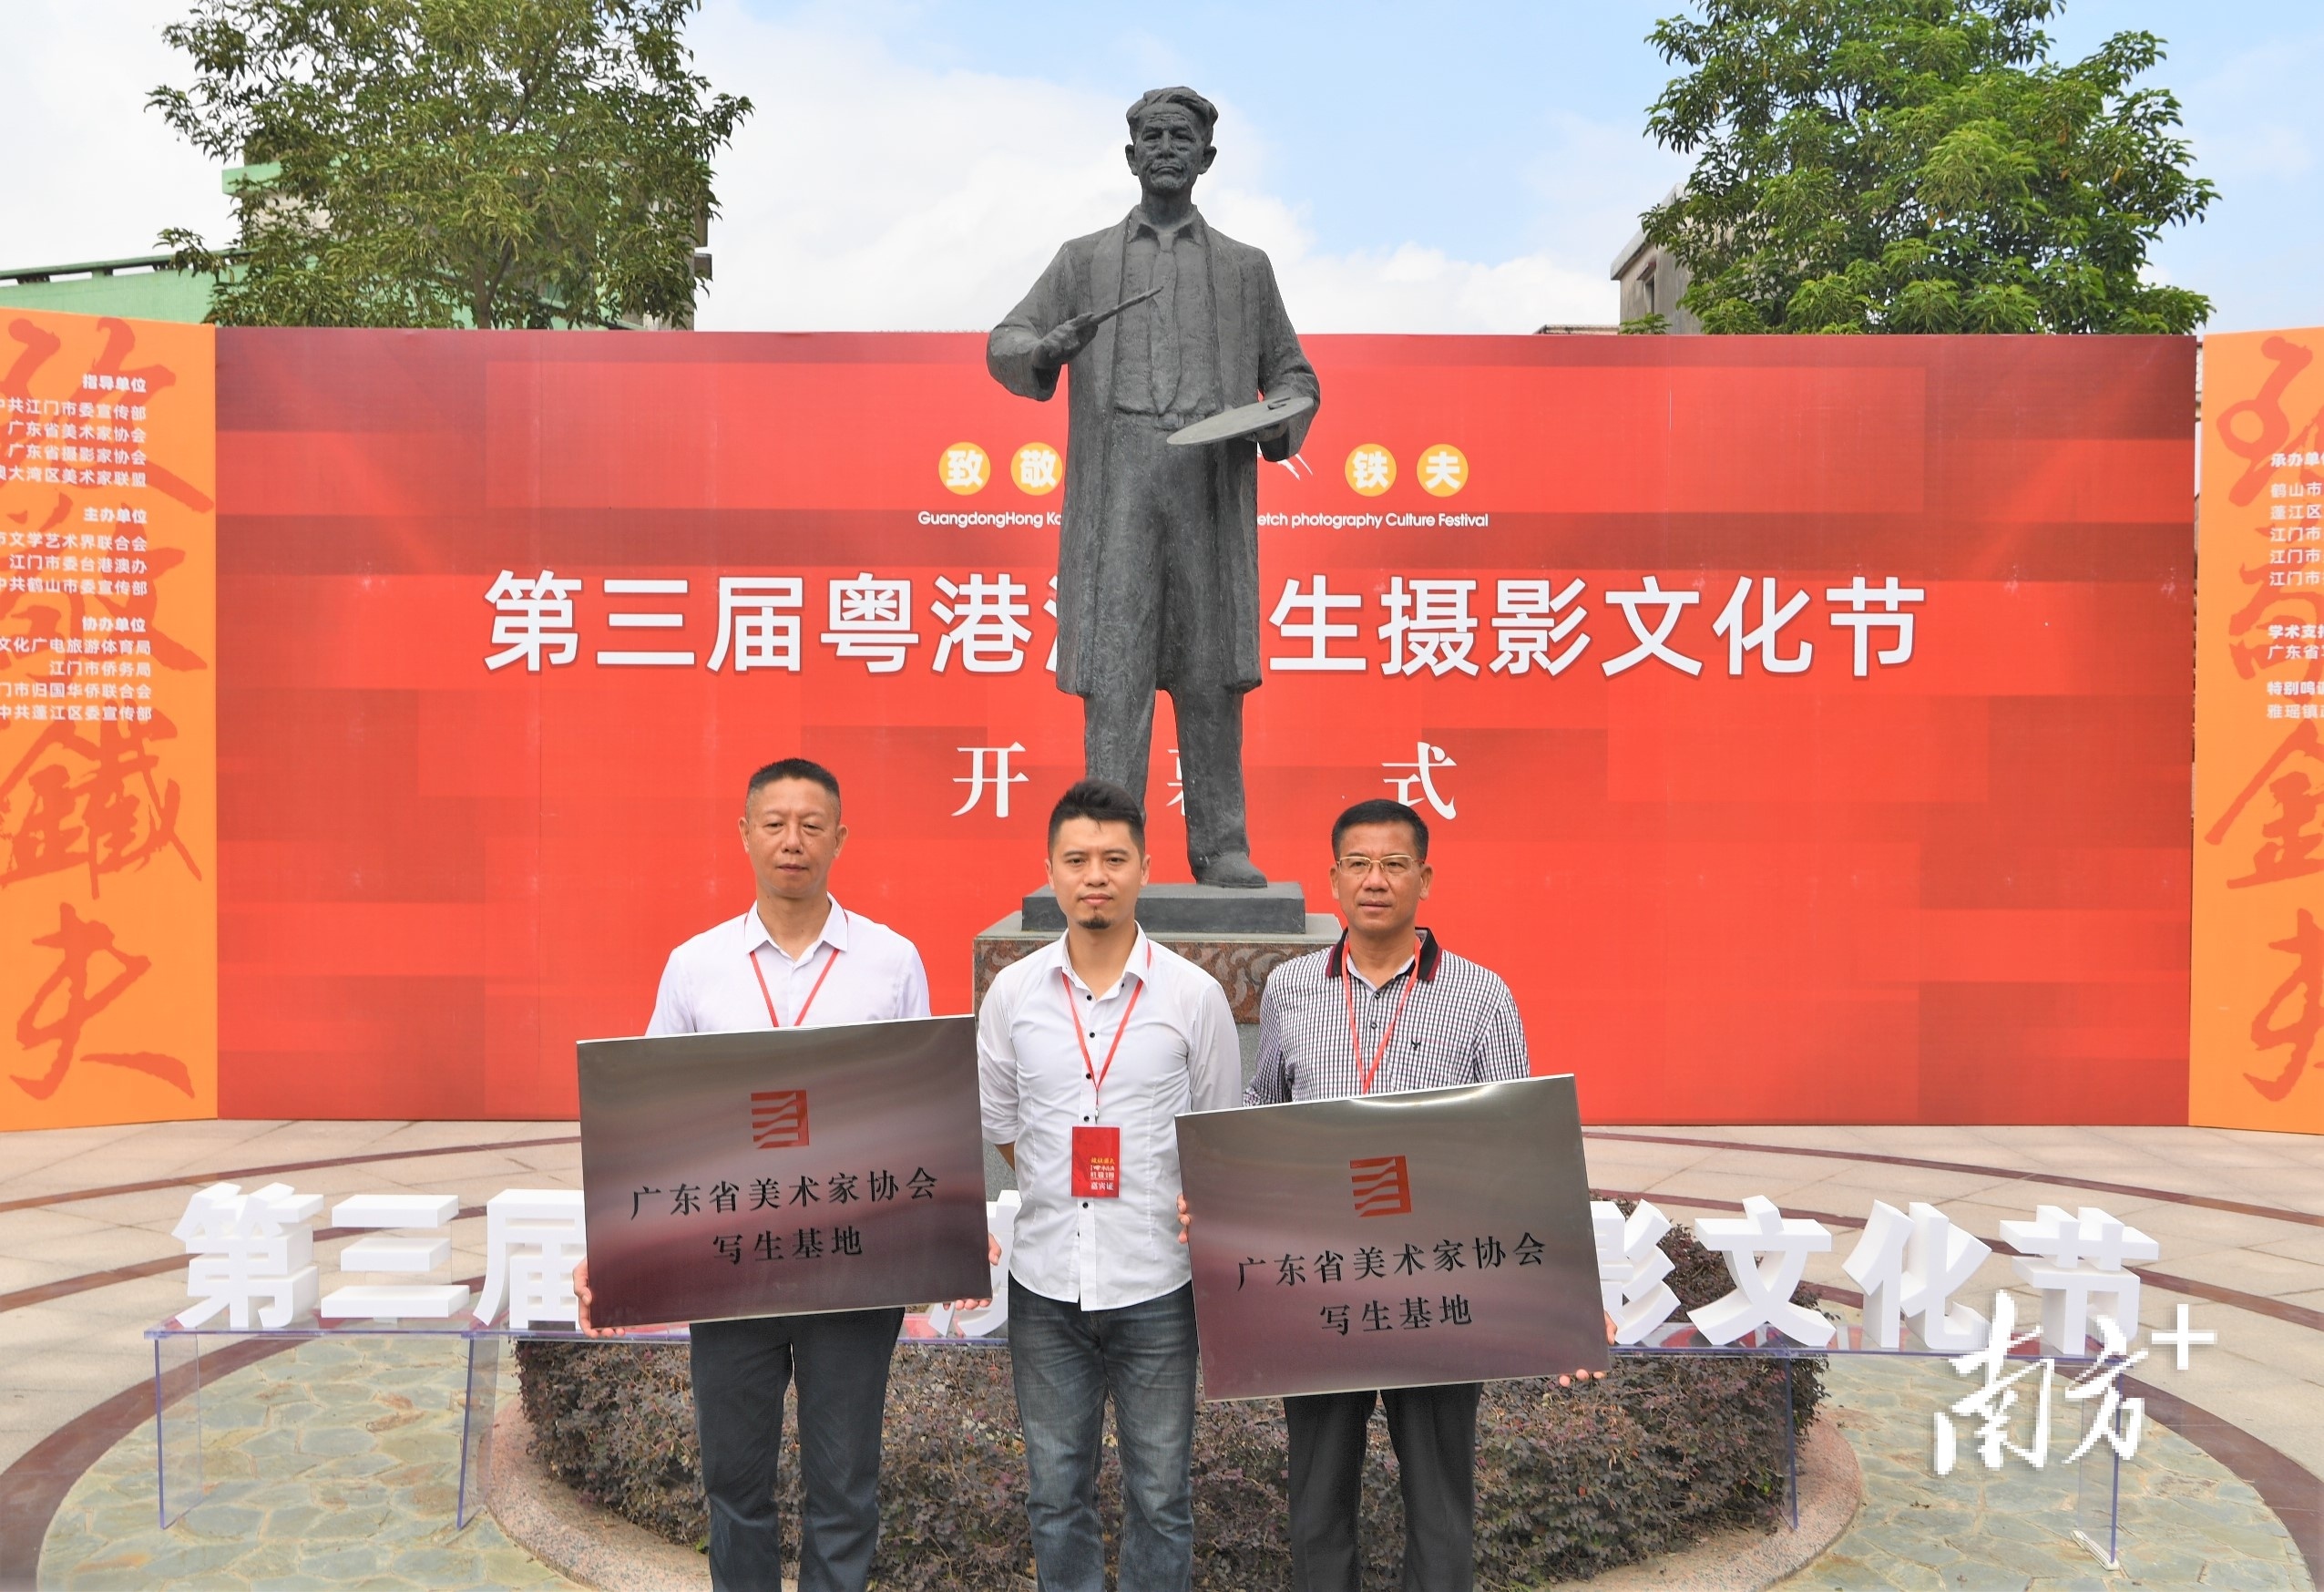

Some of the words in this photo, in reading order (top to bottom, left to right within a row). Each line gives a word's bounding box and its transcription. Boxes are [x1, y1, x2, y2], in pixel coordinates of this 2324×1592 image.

[82, 374, 147, 393] 指导单位
[8, 420, 147, 443] 广东省美术家协会
[8, 443, 147, 466] 广东省摄影家协会
[2270, 452, 2324, 467] 承办单
[947, 449, 1057, 488] 致敬
[1352, 450, 1460, 489] 铁夫
[84, 507, 148, 524] 主办单位
[917, 510, 1044, 529] GuangdongHong
[1257, 512, 1288, 526] etch
[1291, 513, 1383, 529] photography
[1386, 512, 1435, 527] Culture
[1438, 513, 1489, 527] Festival
[2270, 504, 2322, 520] 蓬江区
[2269, 526, 2324, 542] 江门市
[9, 554, 148, 574] 江门市委台港澳办
[2269, 549, 2324, 564] 江门市
[2269, 570, 2324, 586] 江门市
[82, 616, 146, 632] 协办单位
[0, 636, 151, 655] 文化广电旅游体育局
[2268, 644, 2324, 660] 广东省
[49, 660, 151, 677] 江门市侨务局
[0, 704, 152, 722] 中共蓬江区委宣传部
[630, 1166, 938, 1220] 广东省美术家协会
[712, 1226, 863, 1266] 写生基地
[1237, 1231, 1545, 1291] 广东省美术家协会
[1320, 1294, 1472, 1335] 写生基地
